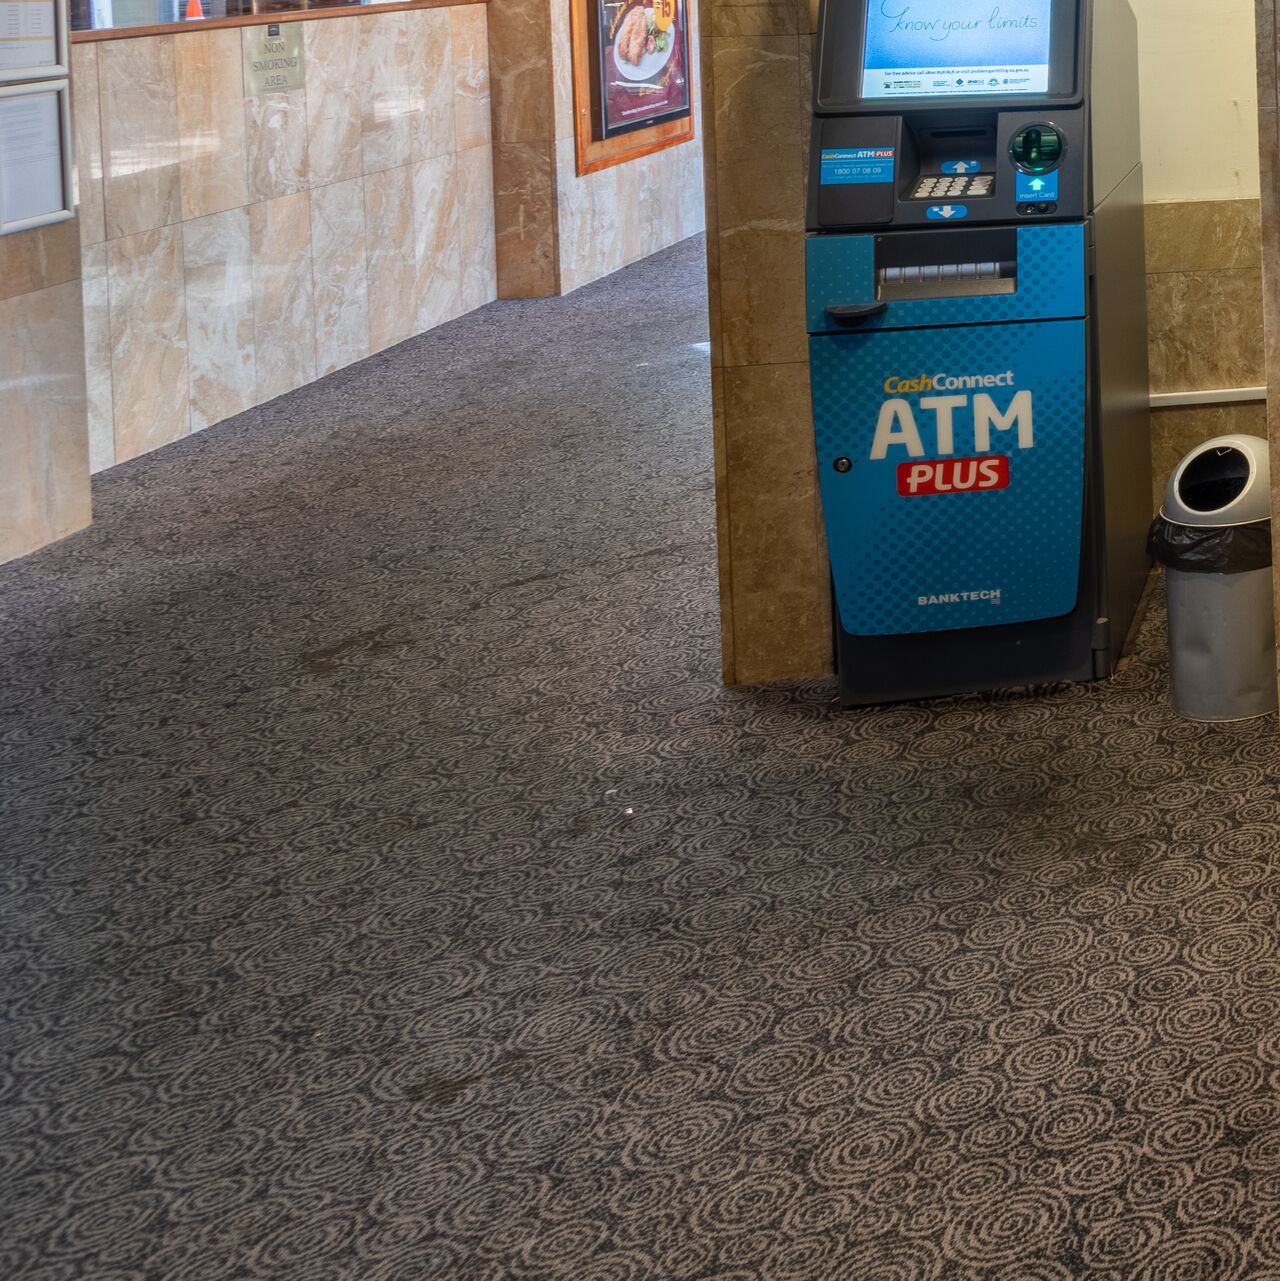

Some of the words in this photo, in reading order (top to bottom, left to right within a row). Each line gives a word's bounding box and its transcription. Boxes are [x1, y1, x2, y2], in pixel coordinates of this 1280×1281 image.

[884, 2, 941, 33] know
[929, 19, 983, 41] your
[988, 6, 1038, 30] limits
[263, 41, 285, 54] NON
[252, 56, 297, 72] SMOKING
[264, 74, 288, 87] AREA
[857, 150, 875, 158] ATM
[883, 369, 1015, 395] CashConnect
[869, 390, 1034, 460] ATM
[906, 459, 1000, 493] PLUS
[917, 589, 1001, 607] BANKTECH
